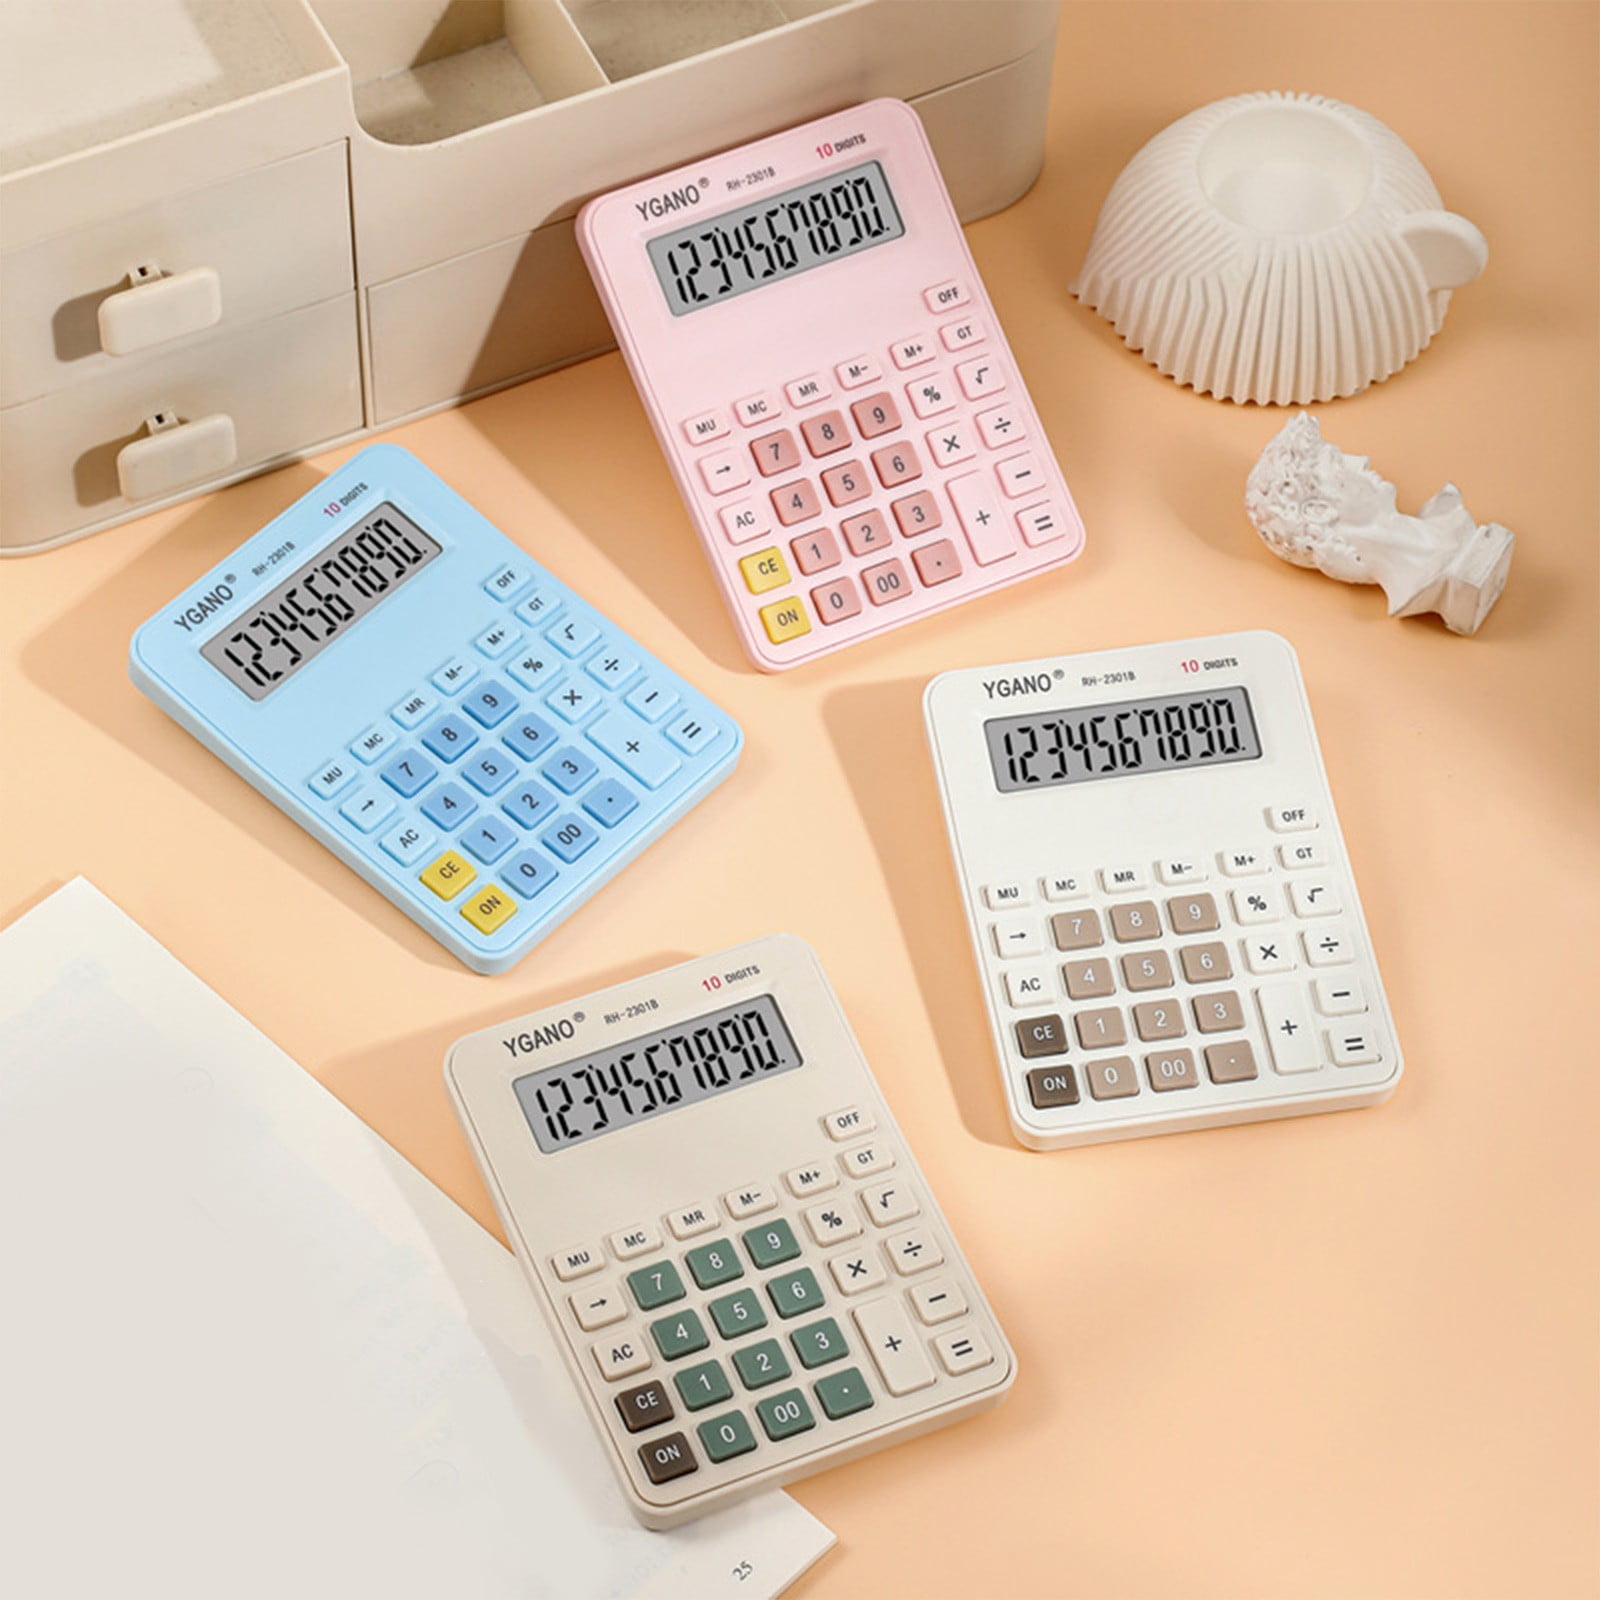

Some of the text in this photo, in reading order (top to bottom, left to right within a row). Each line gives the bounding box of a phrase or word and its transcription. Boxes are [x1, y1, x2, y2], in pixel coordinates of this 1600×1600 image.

[816, 143, 833, 158] 10
[834, 134, 866, 152] DIGITS
[938, 287, 958, 303] OFF
[696, 420, 716, 434] MU
[747, 401, 767, 415] MC
[799, 382, 818, 396] MR
[904, 346, 922, 358] M+
[957, 325, 972, 339] GT
[769, 443, 779, 460] 7
[822, 424, 834, 440] 8
[873, 407, 885, 424] 9
[323, 502, 342, 518] 10
[339, 482, 369, 508] DIGITS
[736, 511, 755, 528] AC
[792, 494, 802, 508] 4
[842, 474, 855, 491] 5
[893, 456, 905, 472] 6
[758, 558, 778, 574] CE
[812, 544, 821, 559] 1
[861, 525, 874, 542] 2
[912, 506, 925, 523] 3
[497, 571, 515, 588] OFF
[777, 609, 798, 626] ON
[830, 592, 843, 609] 0
[877, 572, 900, 592] 00
[323, 767, 342, 784] MU
[364, 734, 383, 750] MC
[405, 698, 425, 714] MR
[487, 631, 504, 645] M+
[529, 597, 543, 611] GT
[1181, 660, 1199, 672] 10
[1203, 658, 1238, 670] DIGITS
[399, 762, 413, 777] 7
[441, 728, 458, 741] 8
[482, 694, 498, 707] 9
[399, 829, 419, 848] AC
[443, 797, 456, 809] 4
[481, 761, 497, 776] 5
[522, 727, 538, 740] 6
[439, 862, 460, 879] CE
[482, 830, 496, 842] 1
[522, 794, 539, 809] 2
[562, 760, 578, 774] 3
[1282, 810, 1304, 822] OFF
[479, 896, 501, 915] ON
[520, 864, 536, 878] 0
[557, 824, 581, 845] 00
[998, 887, 1018, 898] MU
[1056, 879, 1076, 890] MC
[1114, 871, 1135, 882] MR
[1234, 856, 1254, 866] M+
[1296, 848, 1312, 859] GT
[1072, 919, 1081, 934] 7
[1130, 911, 1142, 926] 8
[1189, 904, 1201, 920] 9
[703, 976, 721, 991] 10
[724, 965, 760, 984] DIGITS
[1021, 978, 1040, 992] AC
[1084, 968, 1094, 982] 4
[1143, 960, 1154, 976] 5
[1201, 953, 1213, 968] 6
[1034, 1025, 1053, 1040] CE
[1096, 1018, 1104, 1033] 1
[1155, 1010, 1167, 1026] 2
[1214, 1003, 1226, 1019] 3
[1044, 1076, 1066, 1090] ON
[1105, 1068, 1118, 1084] 0
[1161, 1059, 1185, 1077] 00
[837, 1112, 858, 1128] OFF
[568, 1252, 590, 1267] MU
[624, 1232, 646, 1247] MC
[683, 1210, 705, 1225] MR
[799, 1171, 820, 1184] M+
[857, 1150, 873, 1164] GT
[651, 1273, 661, 1290] 7
[709, 1253, 723, 1269] 8
[767, 1233, 781, 1249] 9
[612, 1344, 633, 1362] AC
[677, 1323, 688, 1338] 4
[733, 1302, 747, 1320] 5
[792, 1282, 806, 1298] 6
[636, 1391, 658, 1409] CE
[700, 1374, 711, 1390] 1
[757, 1353, 772, 1371] 2
[815, 1332, 829, 1349] 3
[656, 1445, 680, 1463] ON
[720, 1425, 735, 1442] 0
[774, 1401, 800, 1422] 00
[732, 1560, 753, 1581] 25
